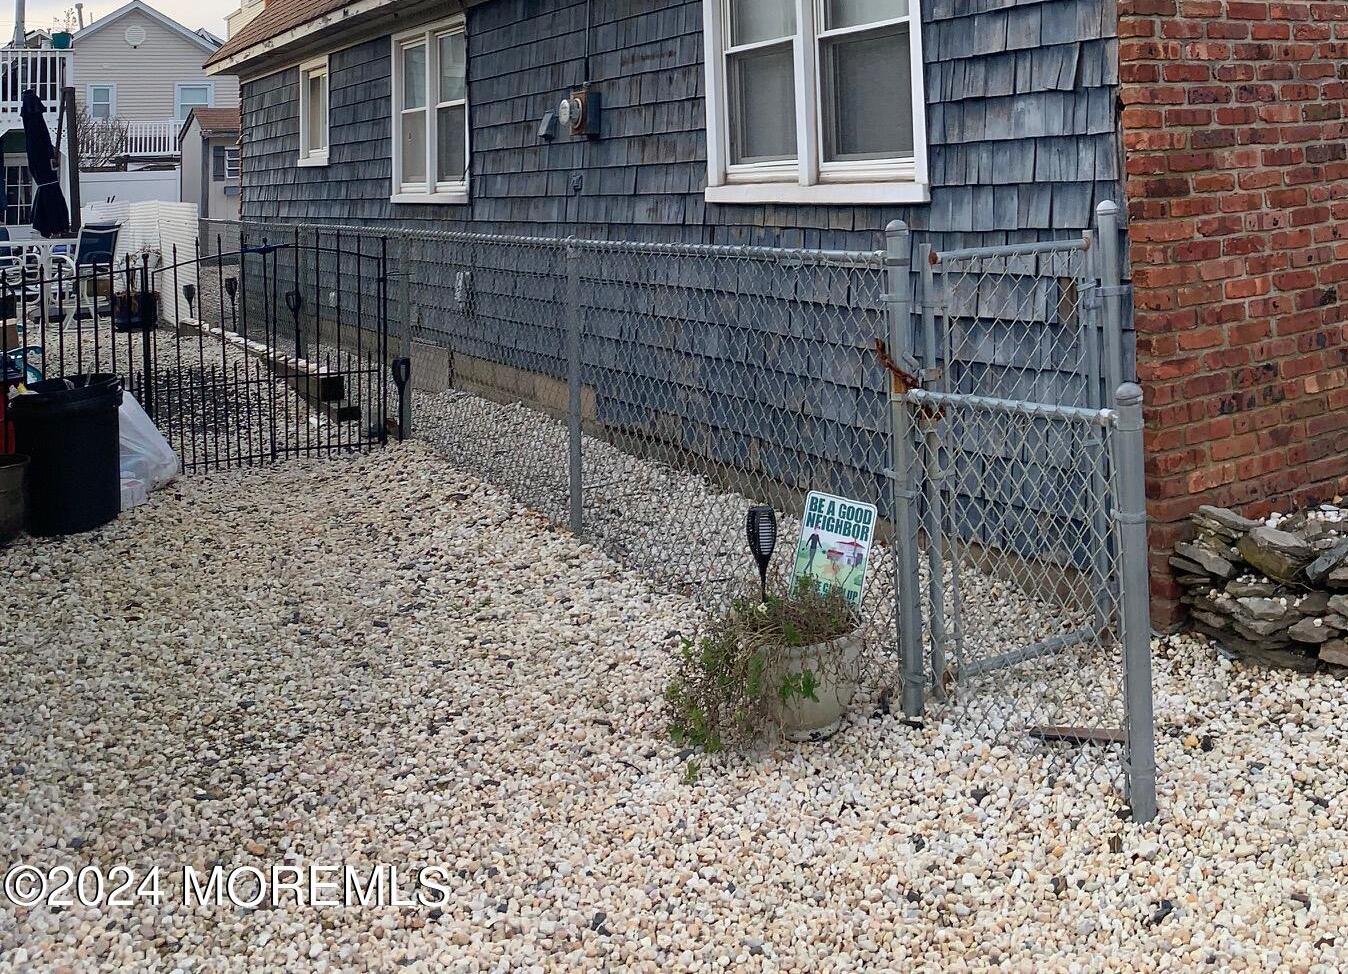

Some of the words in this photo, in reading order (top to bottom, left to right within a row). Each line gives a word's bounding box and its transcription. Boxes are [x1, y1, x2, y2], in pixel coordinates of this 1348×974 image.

[809, 497, 825, 513] BE
[826, 501, 835, 516] A
[838, 504, 872, 525] GOOD
[806, 512, 870, 541] NEIGHBOR
[847, 590, 858, 600] UP
